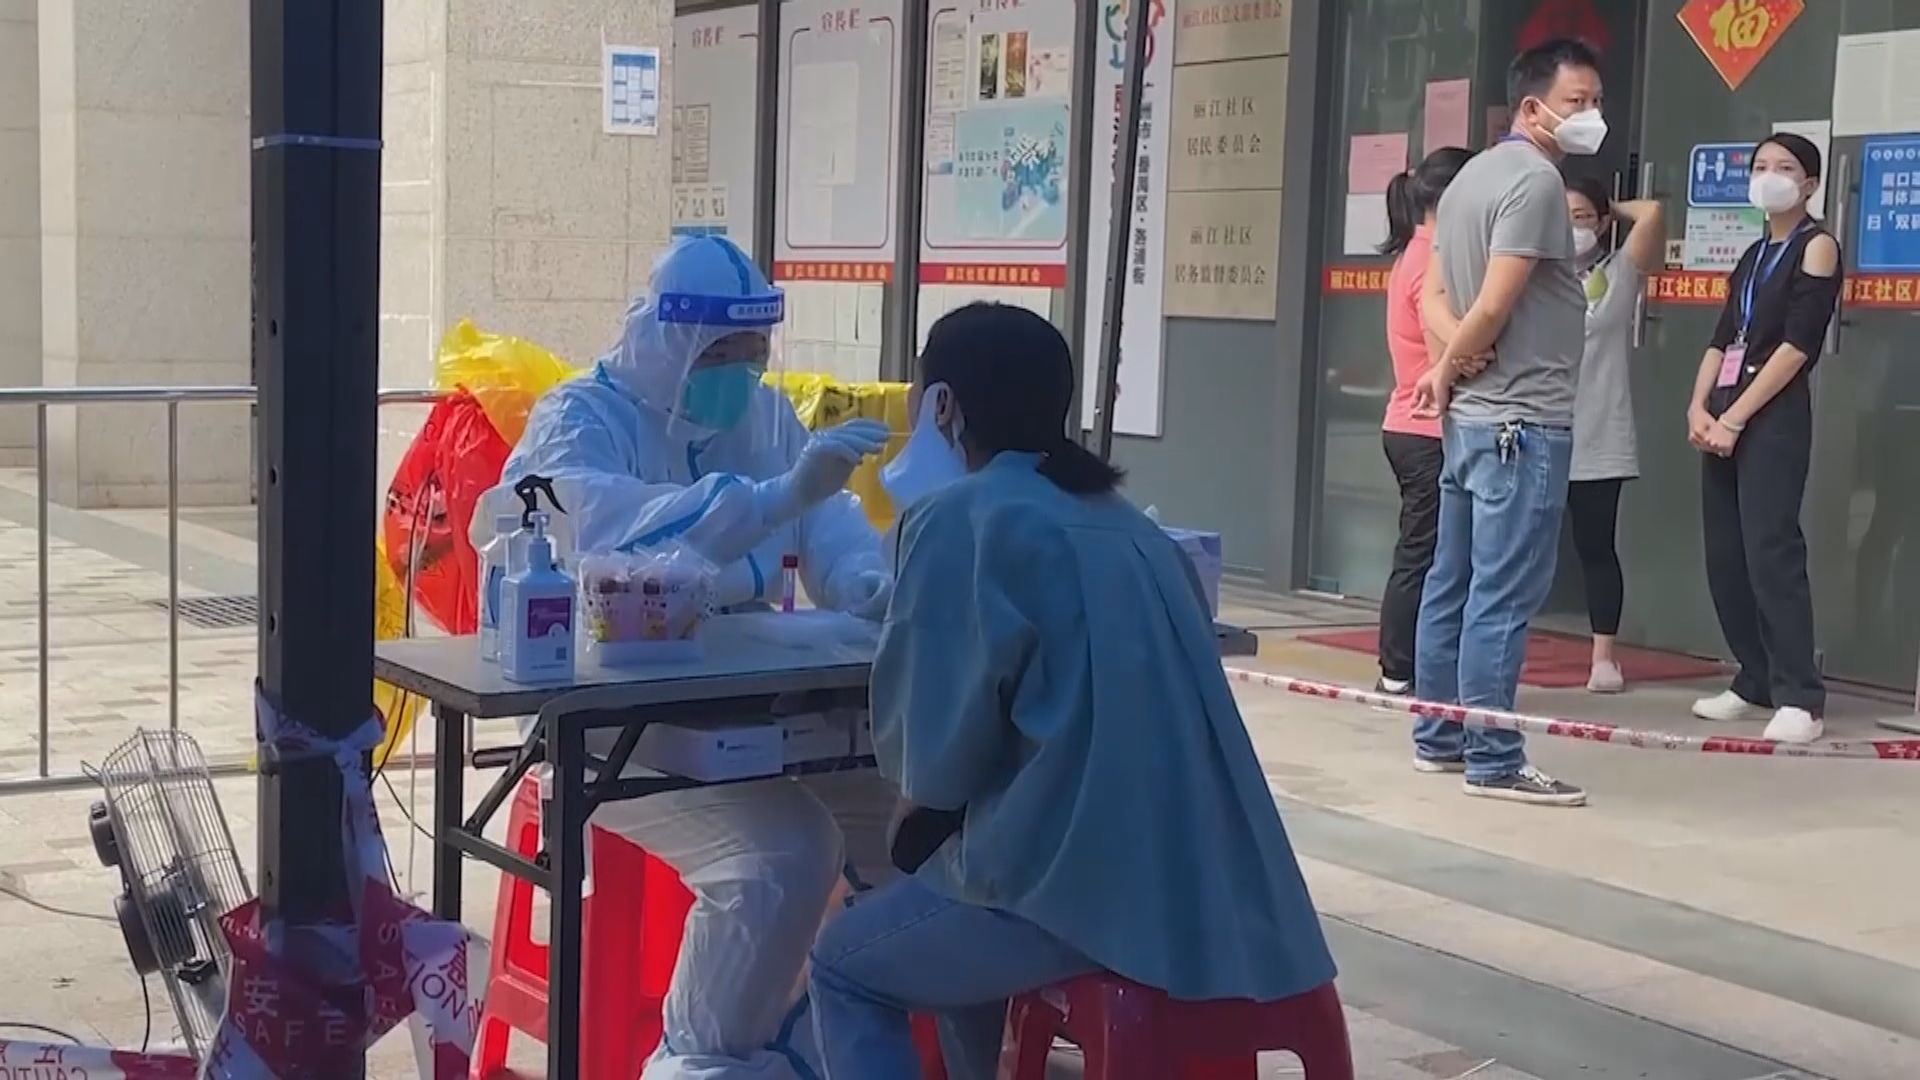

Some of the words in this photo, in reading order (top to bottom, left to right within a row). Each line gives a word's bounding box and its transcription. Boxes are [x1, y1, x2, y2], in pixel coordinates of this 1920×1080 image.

[1709, 0, 1770, 51] 福
[1193, 96, 1254, 118] 丽江社区
[1187, 133, 1261, 156] 居民委员会
[1190, 224, 1252, 245] 丽江社区
[233, 1012, 347, 1046] SAFE
